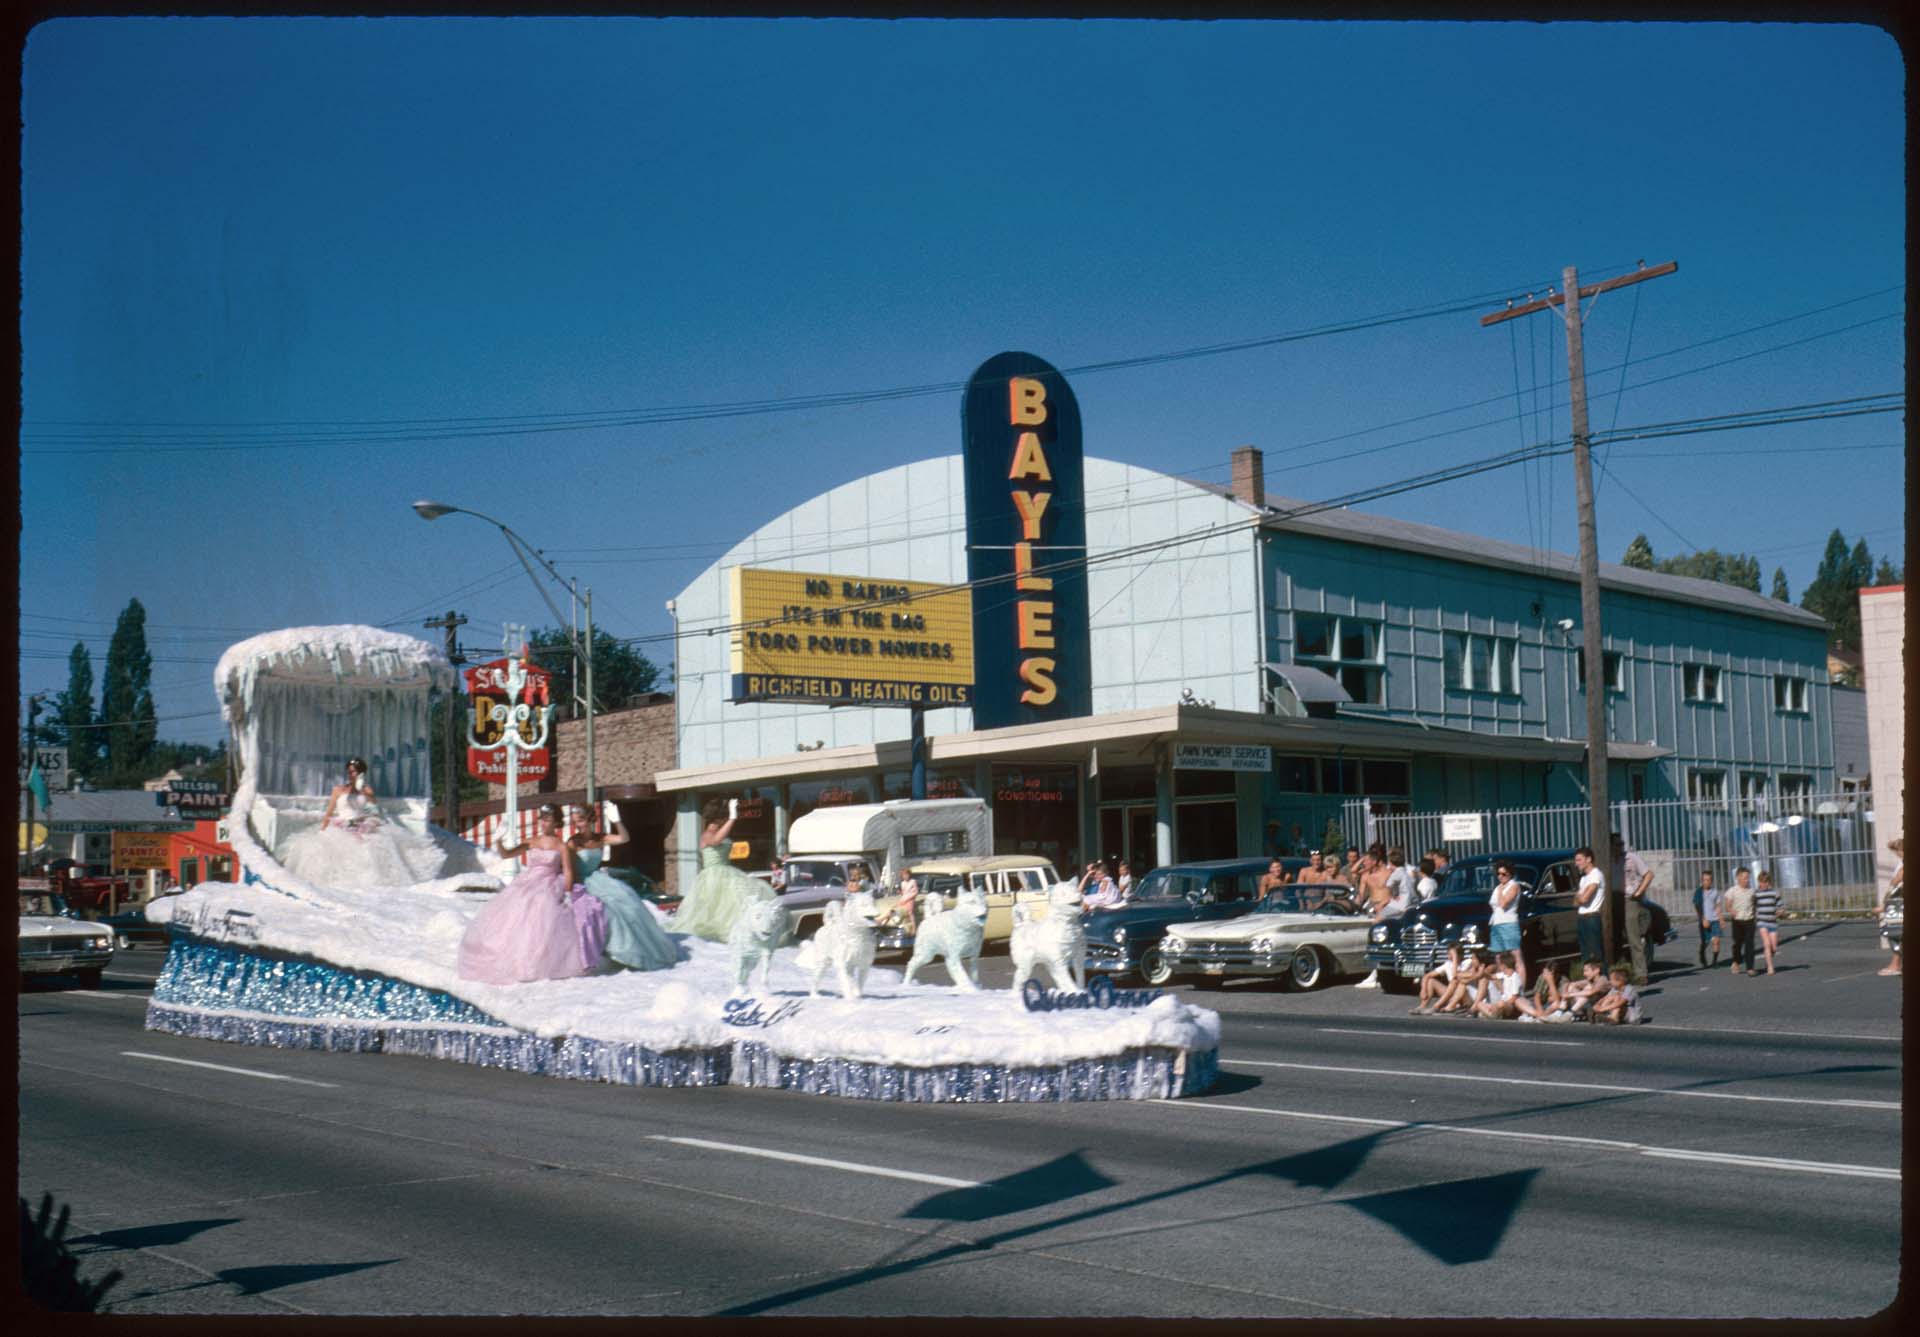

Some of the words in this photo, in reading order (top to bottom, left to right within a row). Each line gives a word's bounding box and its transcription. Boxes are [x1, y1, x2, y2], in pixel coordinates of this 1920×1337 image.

[1008, 377, 1056, 705] BAYLES
[805, 579, 830, 597] NO
[823, 608, 842, 626] IN
[850, 610, 884, 628] THE
[892, 613, 926, 631] BAG
[808, 635, 872, 655] POWER
[880, 639, 954, 660] MOWERS
[750, 678, 843, 697] RICHFIELD
[851, 681, 923, 701] HEATING
[930, 686, 968, 703] OILS
[1235, 746, 1268, 759] SERVICE
[166, 792, 229, 807] PAINT
[997, 790, 1063, 801] CONDITIONING
